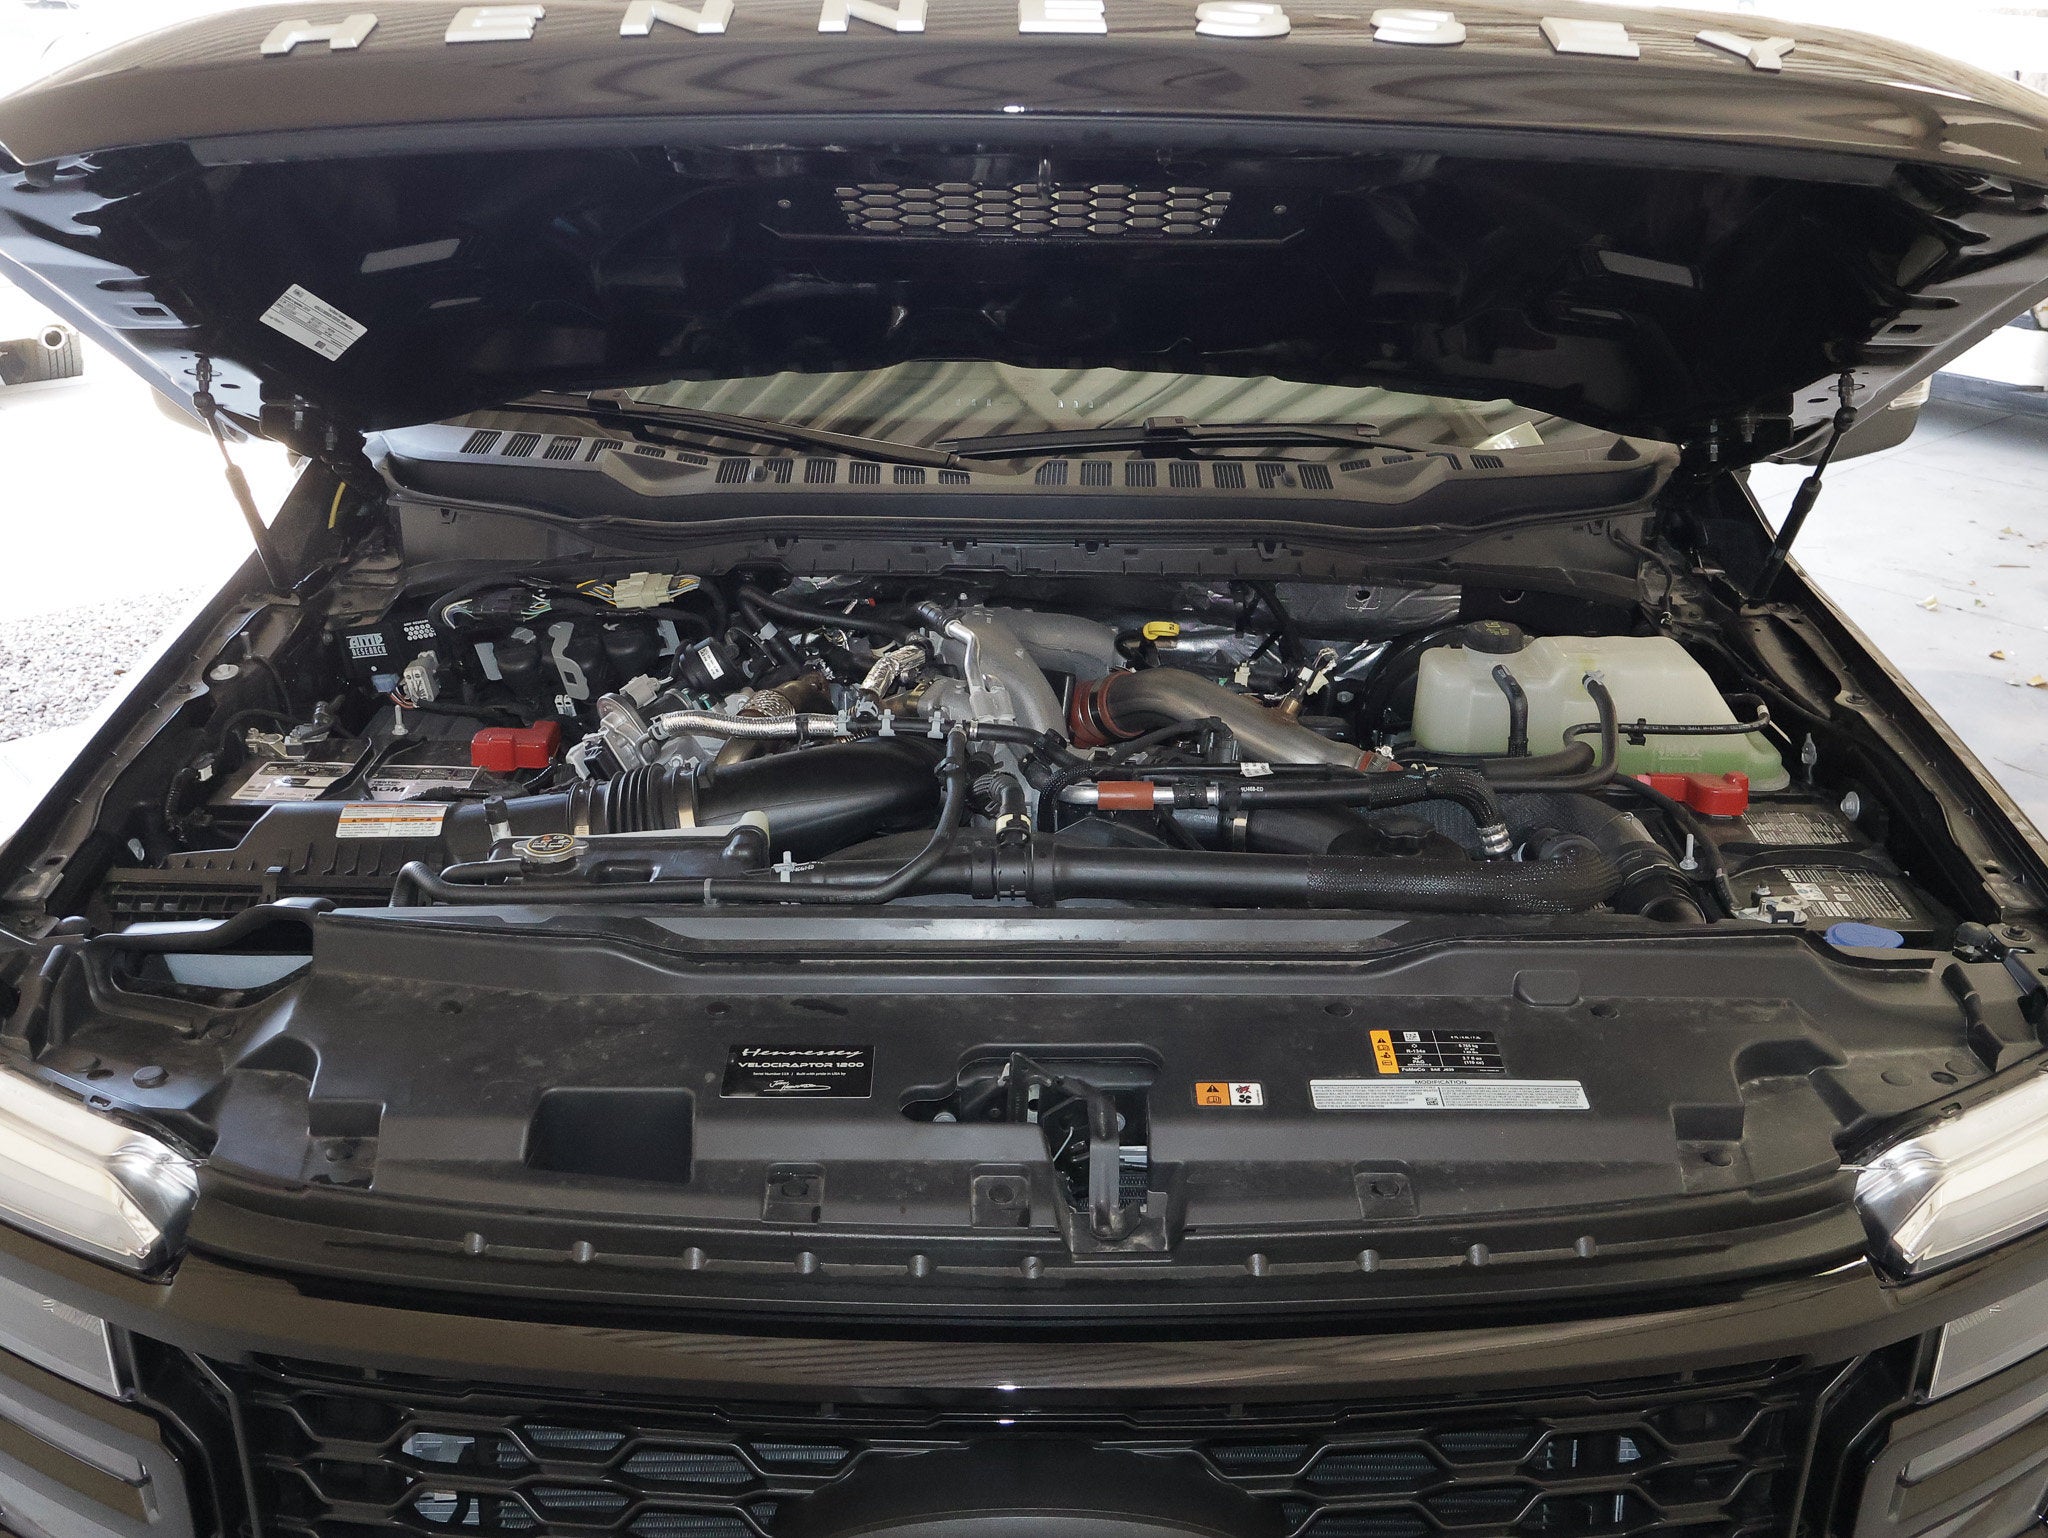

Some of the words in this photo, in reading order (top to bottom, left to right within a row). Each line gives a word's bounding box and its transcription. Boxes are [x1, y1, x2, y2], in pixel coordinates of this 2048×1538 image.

[260, 0, 1796, 70] HENNESSEY
[346, 633, 384, 649] AMP
[351, 645, 387, 656] RESEARCH
[741, 1048, 864, 1059] Hennessey
